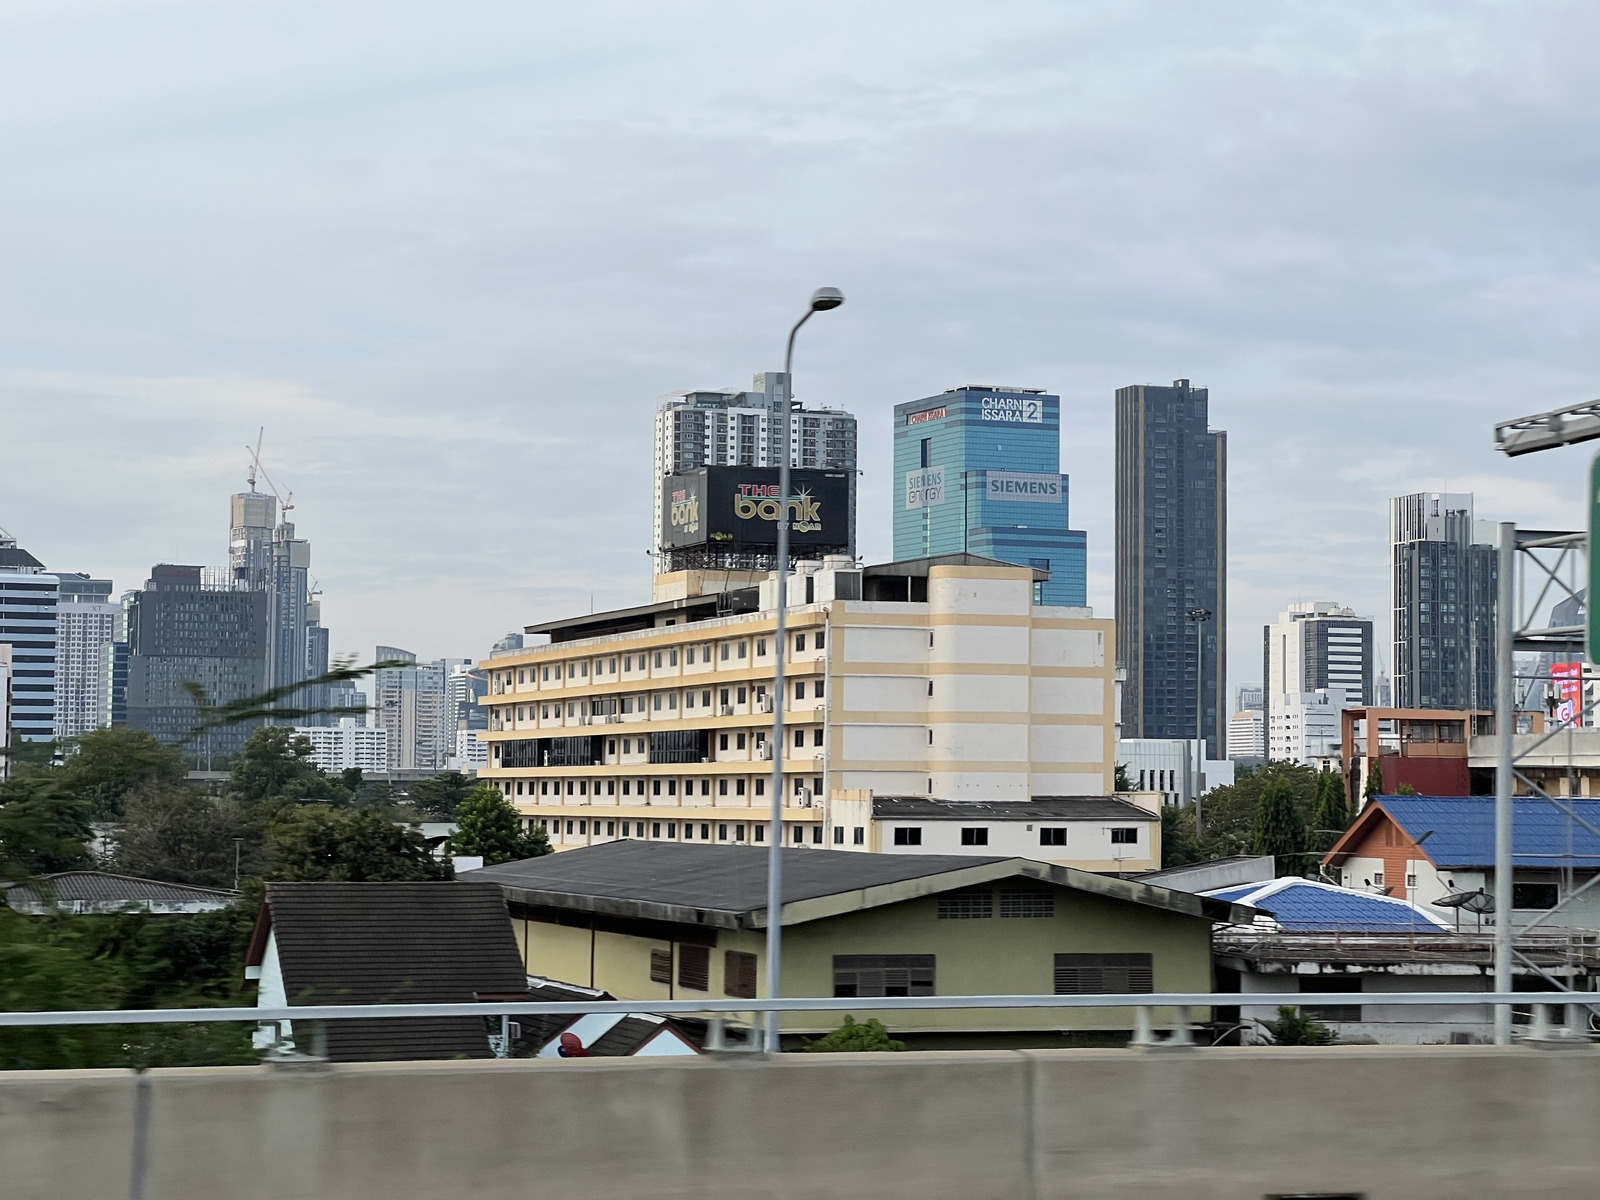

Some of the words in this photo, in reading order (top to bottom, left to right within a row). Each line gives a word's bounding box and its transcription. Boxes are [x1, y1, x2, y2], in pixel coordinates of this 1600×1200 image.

[981, 397, 1022, 410] CHARN
[1027, 401, 1038, 420] 2
[981, 409, 1023, 422] ISSARA
[738, 483, 780, 497] THE
[991, 479, 1057, 495] SIEMENS
[672, 489, 686, 504] THE
[734, 493, 821, 522] bank
